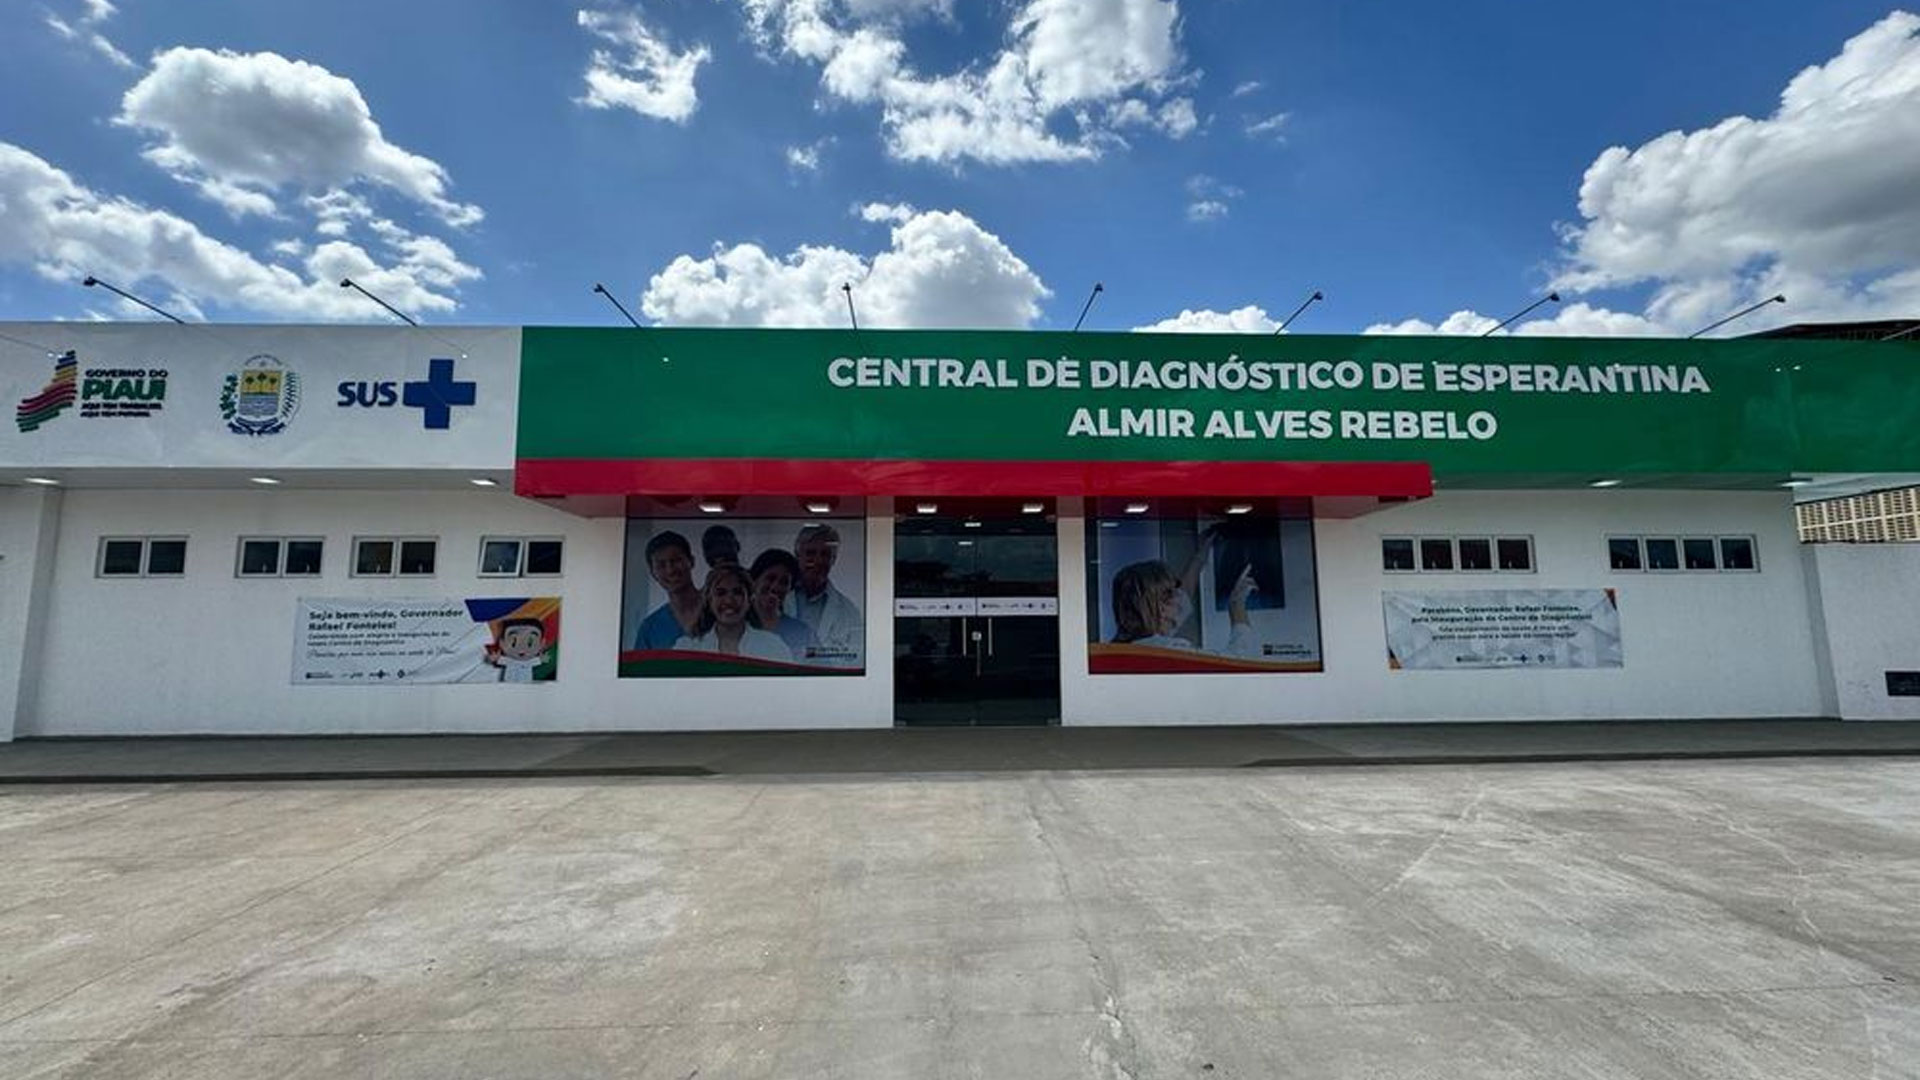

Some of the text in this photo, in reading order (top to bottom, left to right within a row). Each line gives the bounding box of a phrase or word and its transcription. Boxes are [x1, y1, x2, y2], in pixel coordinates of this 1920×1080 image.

[85, 368, 169, 379] GOVERNO DO
[827, 355, 1711, 393] CENTRAL DE DIAGNÓSTICO DE ESPERANTINA
[337, 381, 398, 408] SUS
[1067, 408, 1498, 440] ALMIR ALVES REBELO
[309, 608, 464, 621] Seja bem-vindo, Governador
[308, 621, 343, 631] Rafael
